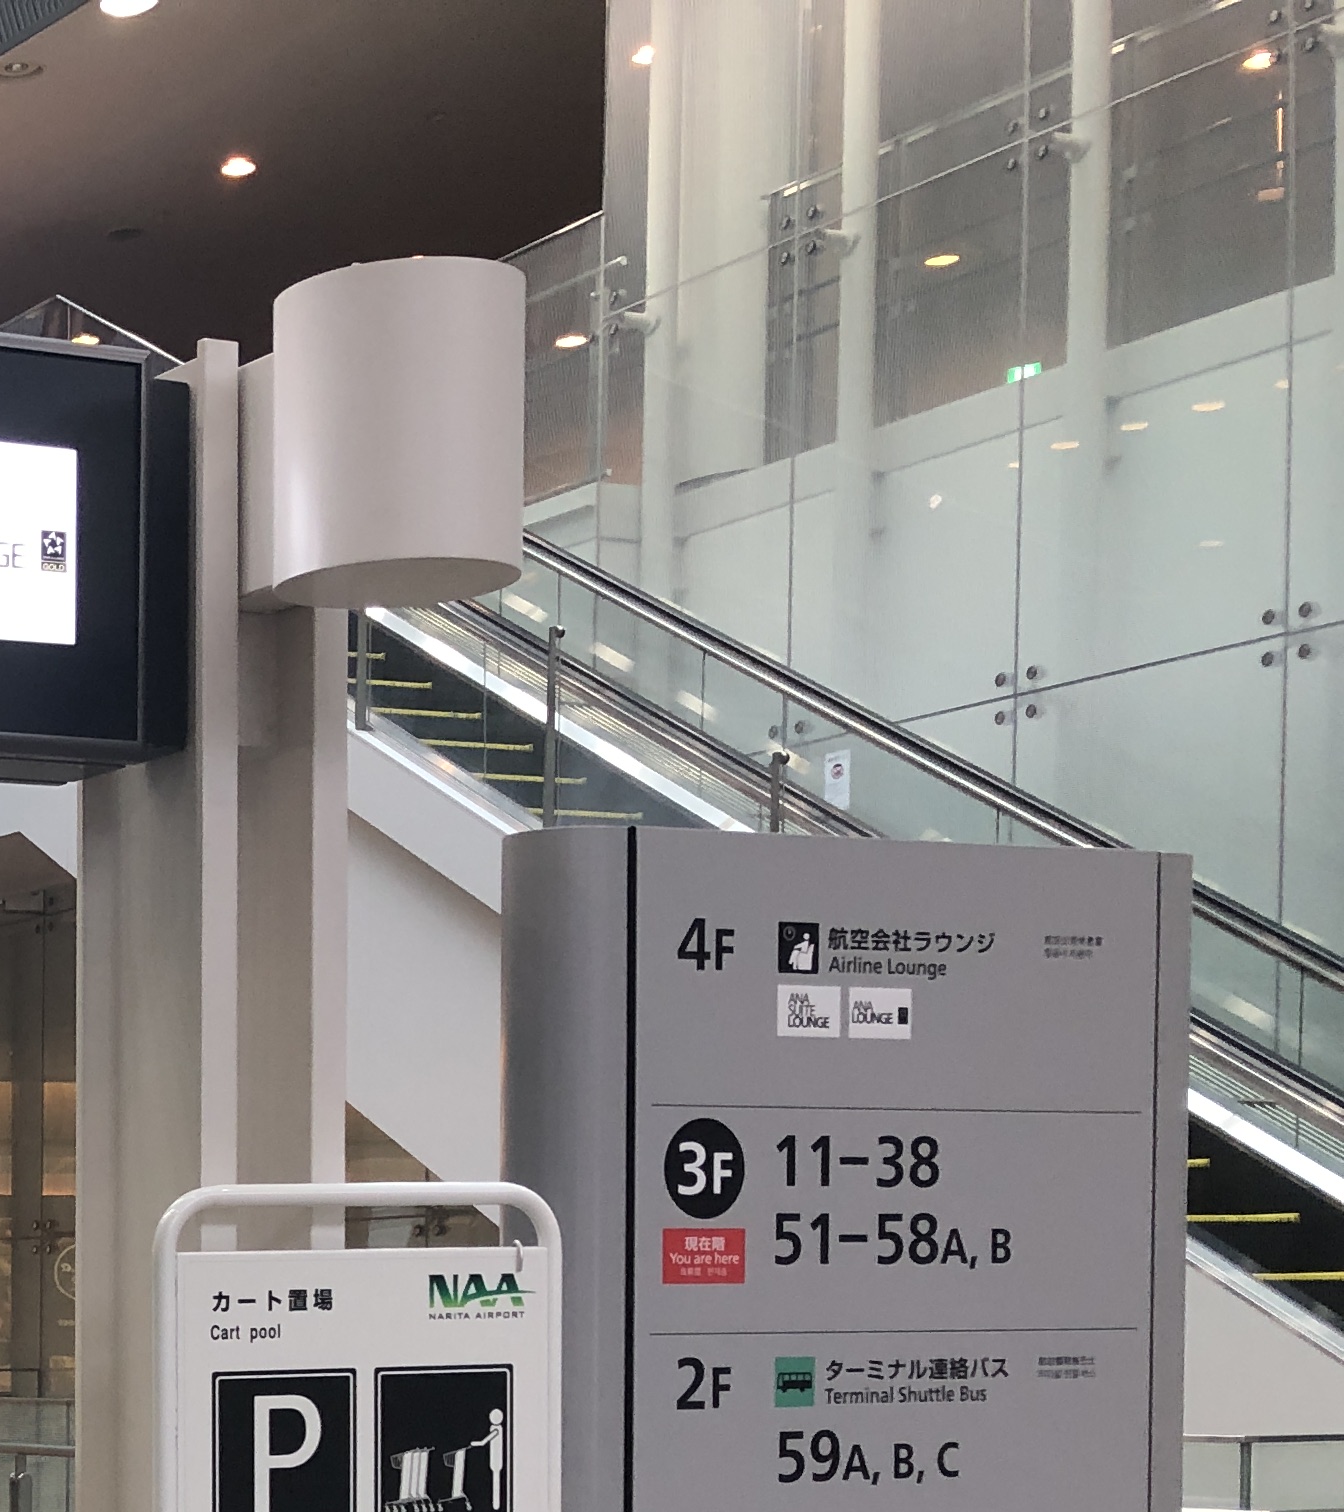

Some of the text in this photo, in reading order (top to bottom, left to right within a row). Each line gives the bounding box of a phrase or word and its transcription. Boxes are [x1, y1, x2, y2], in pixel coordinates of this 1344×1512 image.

[678, 918, 735, 970] 4F
[828, 927, 995, 953] 航空会社ラウンジ
[829, 957, 947, 980] Airline Lounge
[788, 1013, 829, 1028] LOUNGE
[852, 1010, 893, 1024] LOUNGE
[677, 1141, 733, 1195] 3F
[776, 1135, 939, 1188] 11-38
[670, 1252, 740, 1264] You are here
[991, 1229, 1012, 1264] B
[212, 1288, 334, 1312] カート置場
[429, 1273, 536, 1309] NAA
[429, 1310, 525, 1320] NARITA AIRPORT
[211, 1323, 282, 1343] Cart pool
[825, 1356, 1009, 1381] ターミナル連絡バス
[676, 1357, 732, 1410] 2F
[825, 1386, 987, 1404] Terminal Shuttle Bus
[937, 1441, 960, 1477] C
